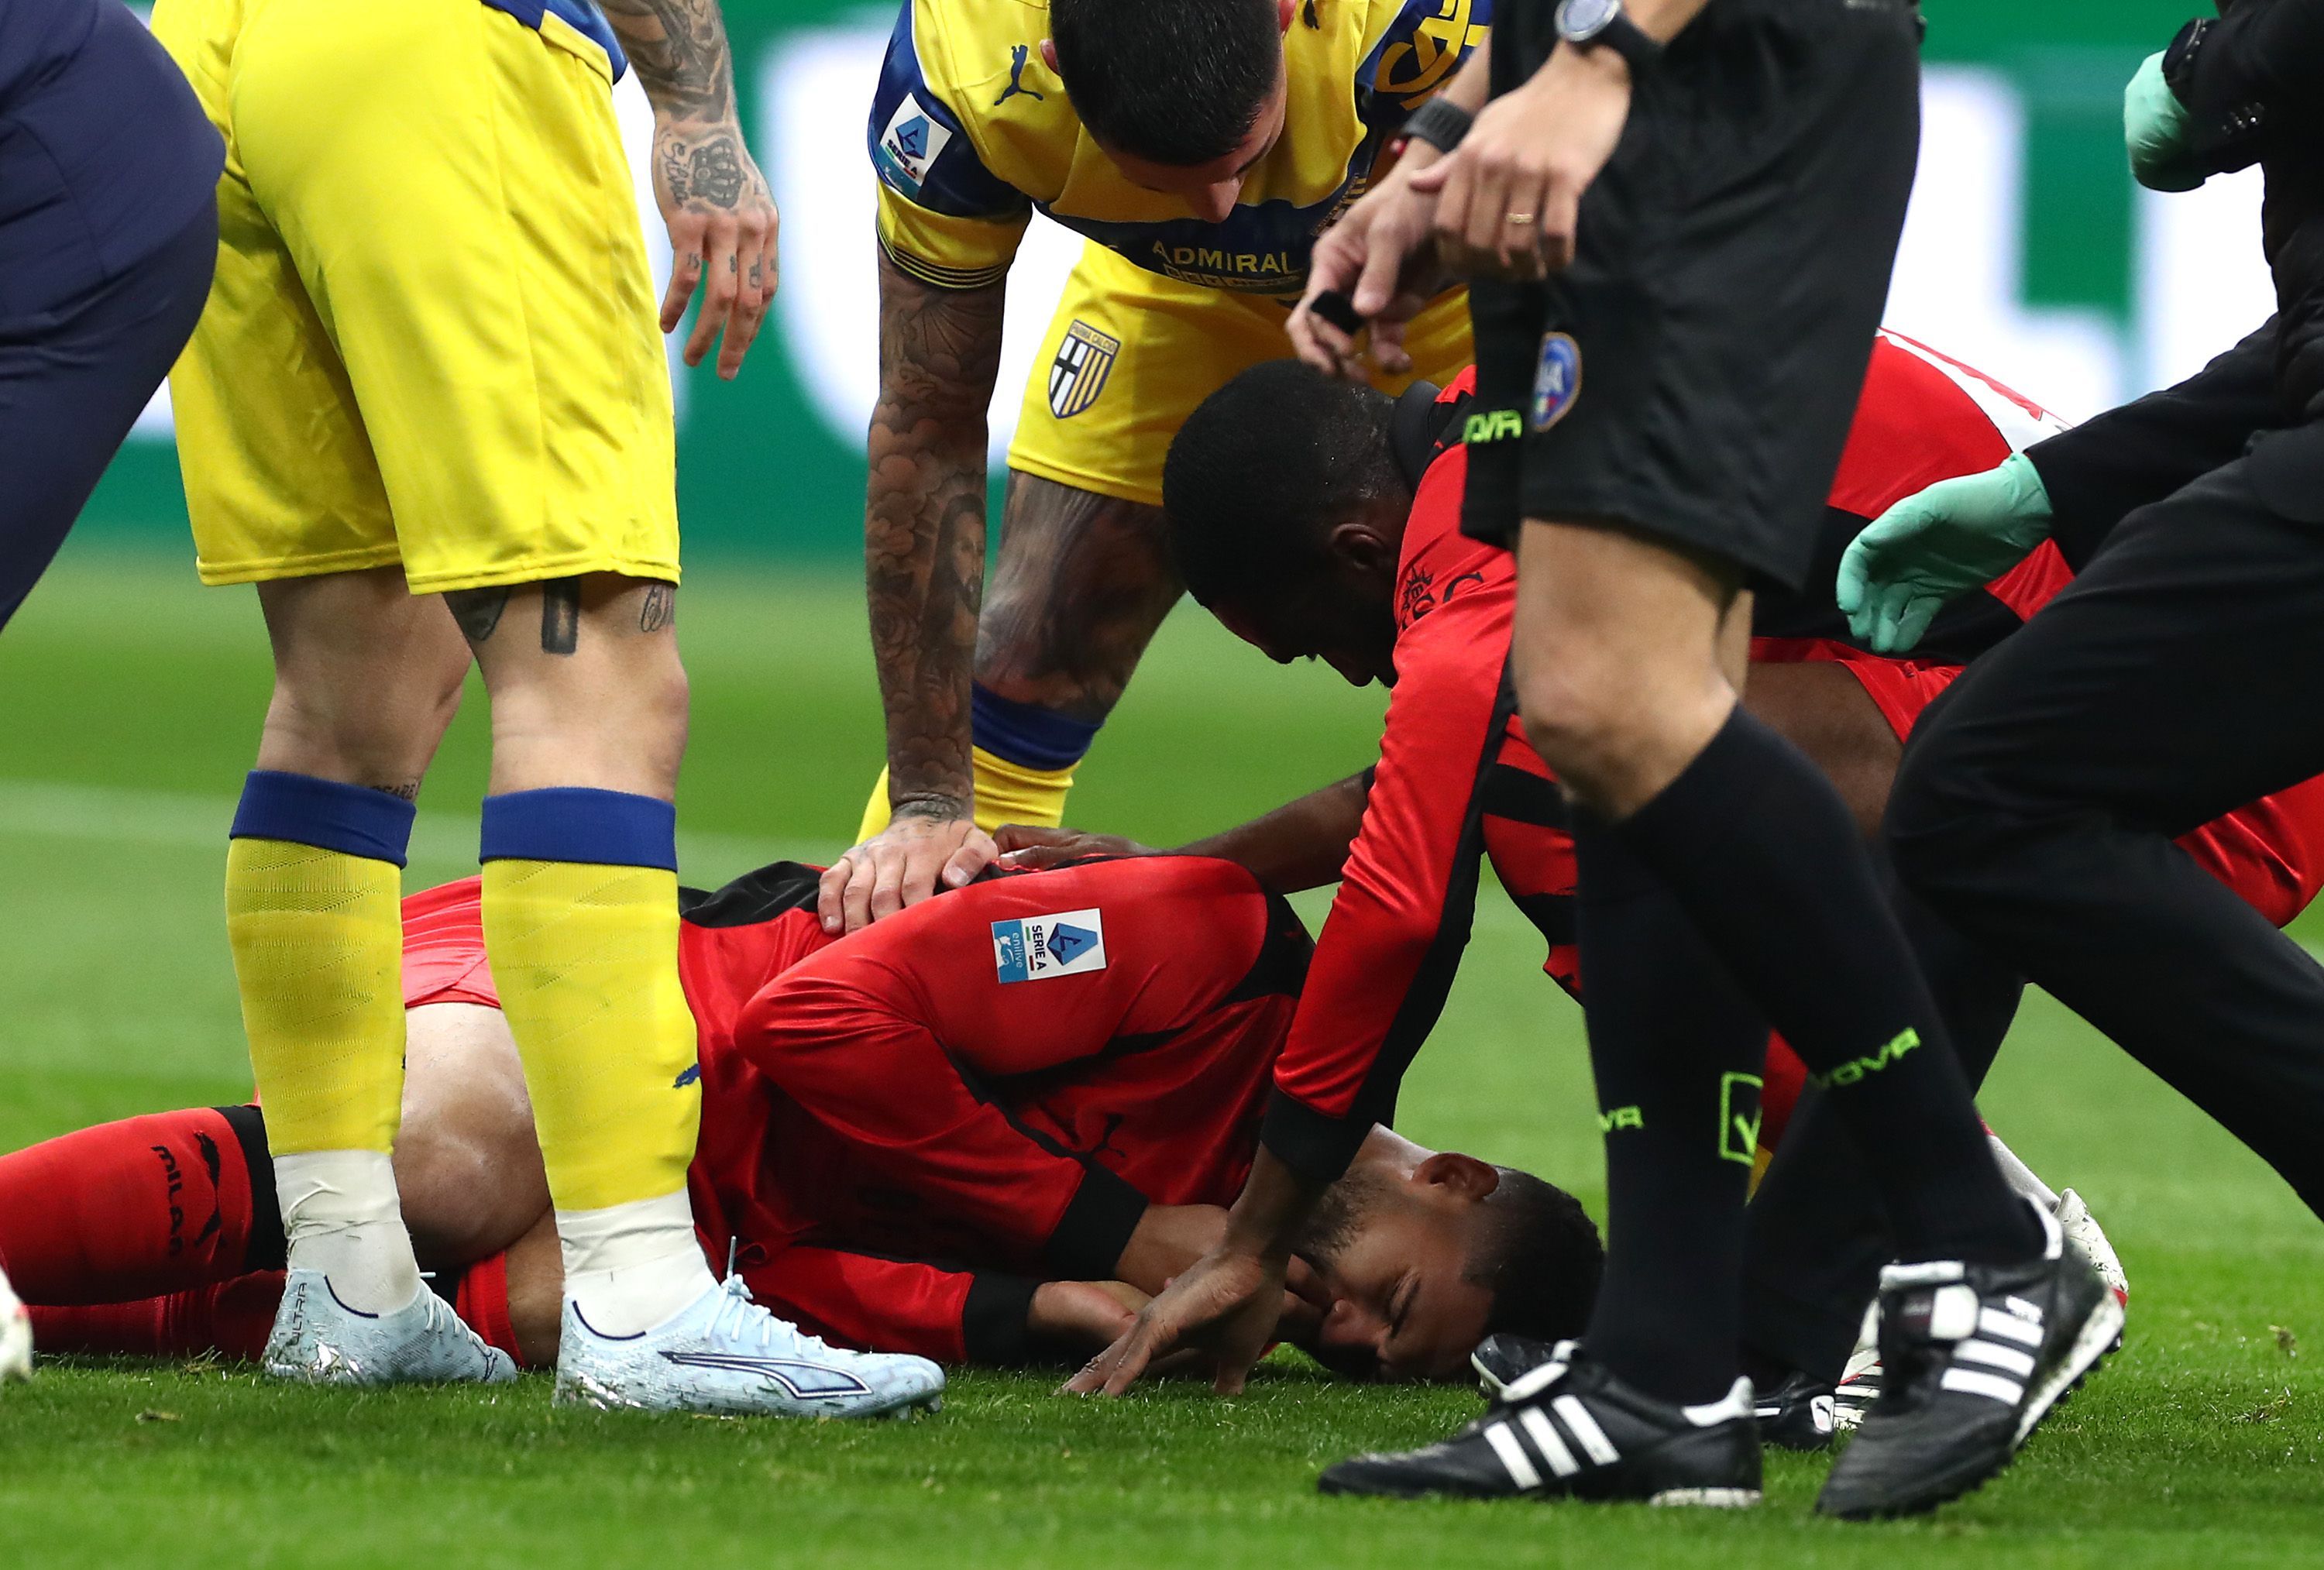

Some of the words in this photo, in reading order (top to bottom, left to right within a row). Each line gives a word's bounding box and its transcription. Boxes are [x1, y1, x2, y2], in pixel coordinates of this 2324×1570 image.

[887, 139, 911, 167] SERIE
[911, 167, 918, 175] A
[1153, 240, 1303, 274] ADMIRAL
[1012, 932, 1023, 968] enilive
[1032, 925, 1046, 960] SERIE
[1037, 961, 1047, 971] A
[286, 1282, 308, 1346] ULTRA
